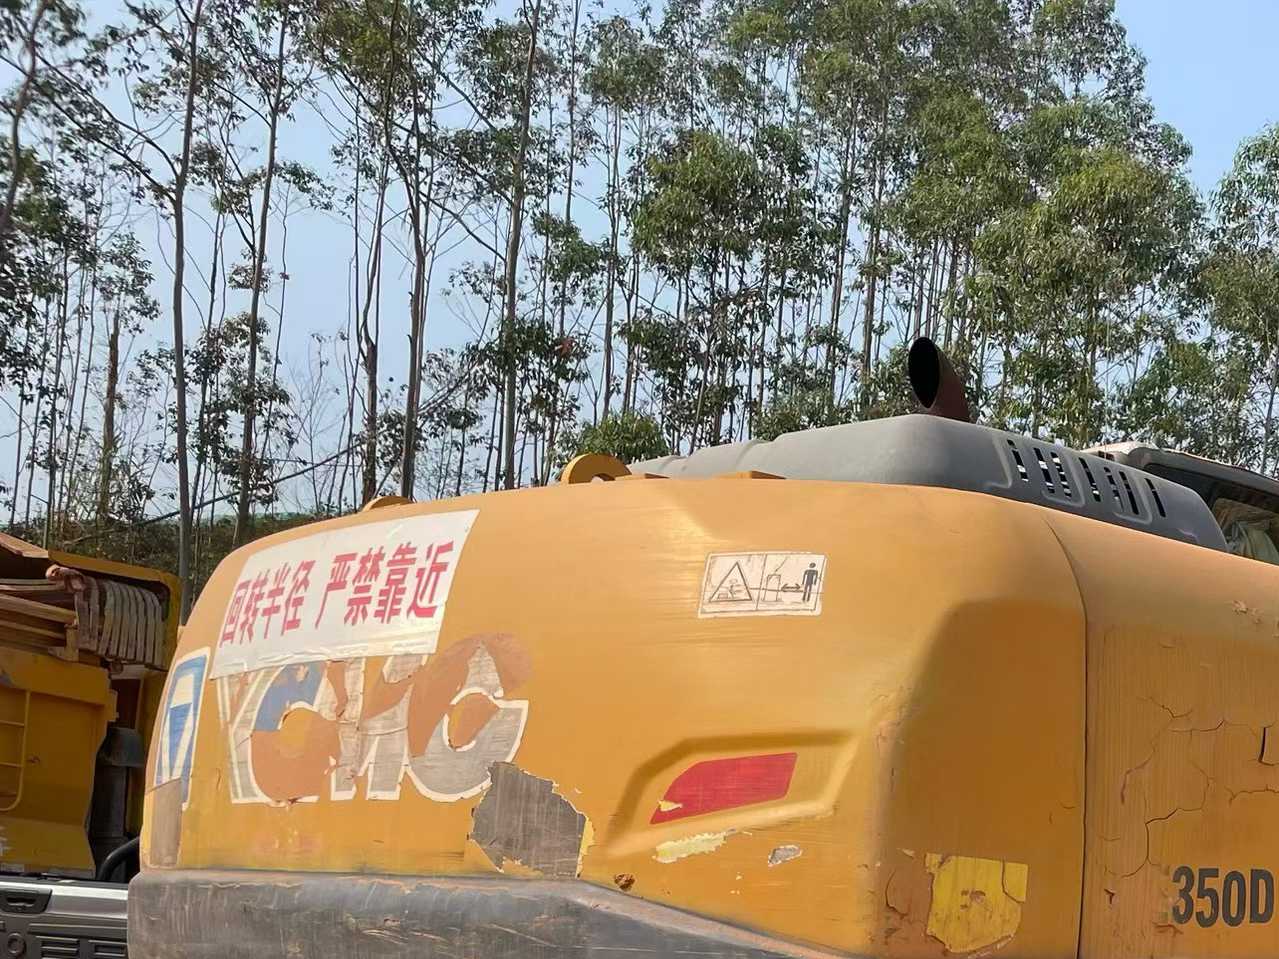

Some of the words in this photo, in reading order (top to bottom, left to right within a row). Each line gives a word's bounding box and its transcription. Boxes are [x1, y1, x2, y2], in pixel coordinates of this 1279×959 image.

[219, 560, 316, 648] 回转半径
[315, 540, 454, 629] 严禁靠近
[1171, 865, 1275, 928] 350D
